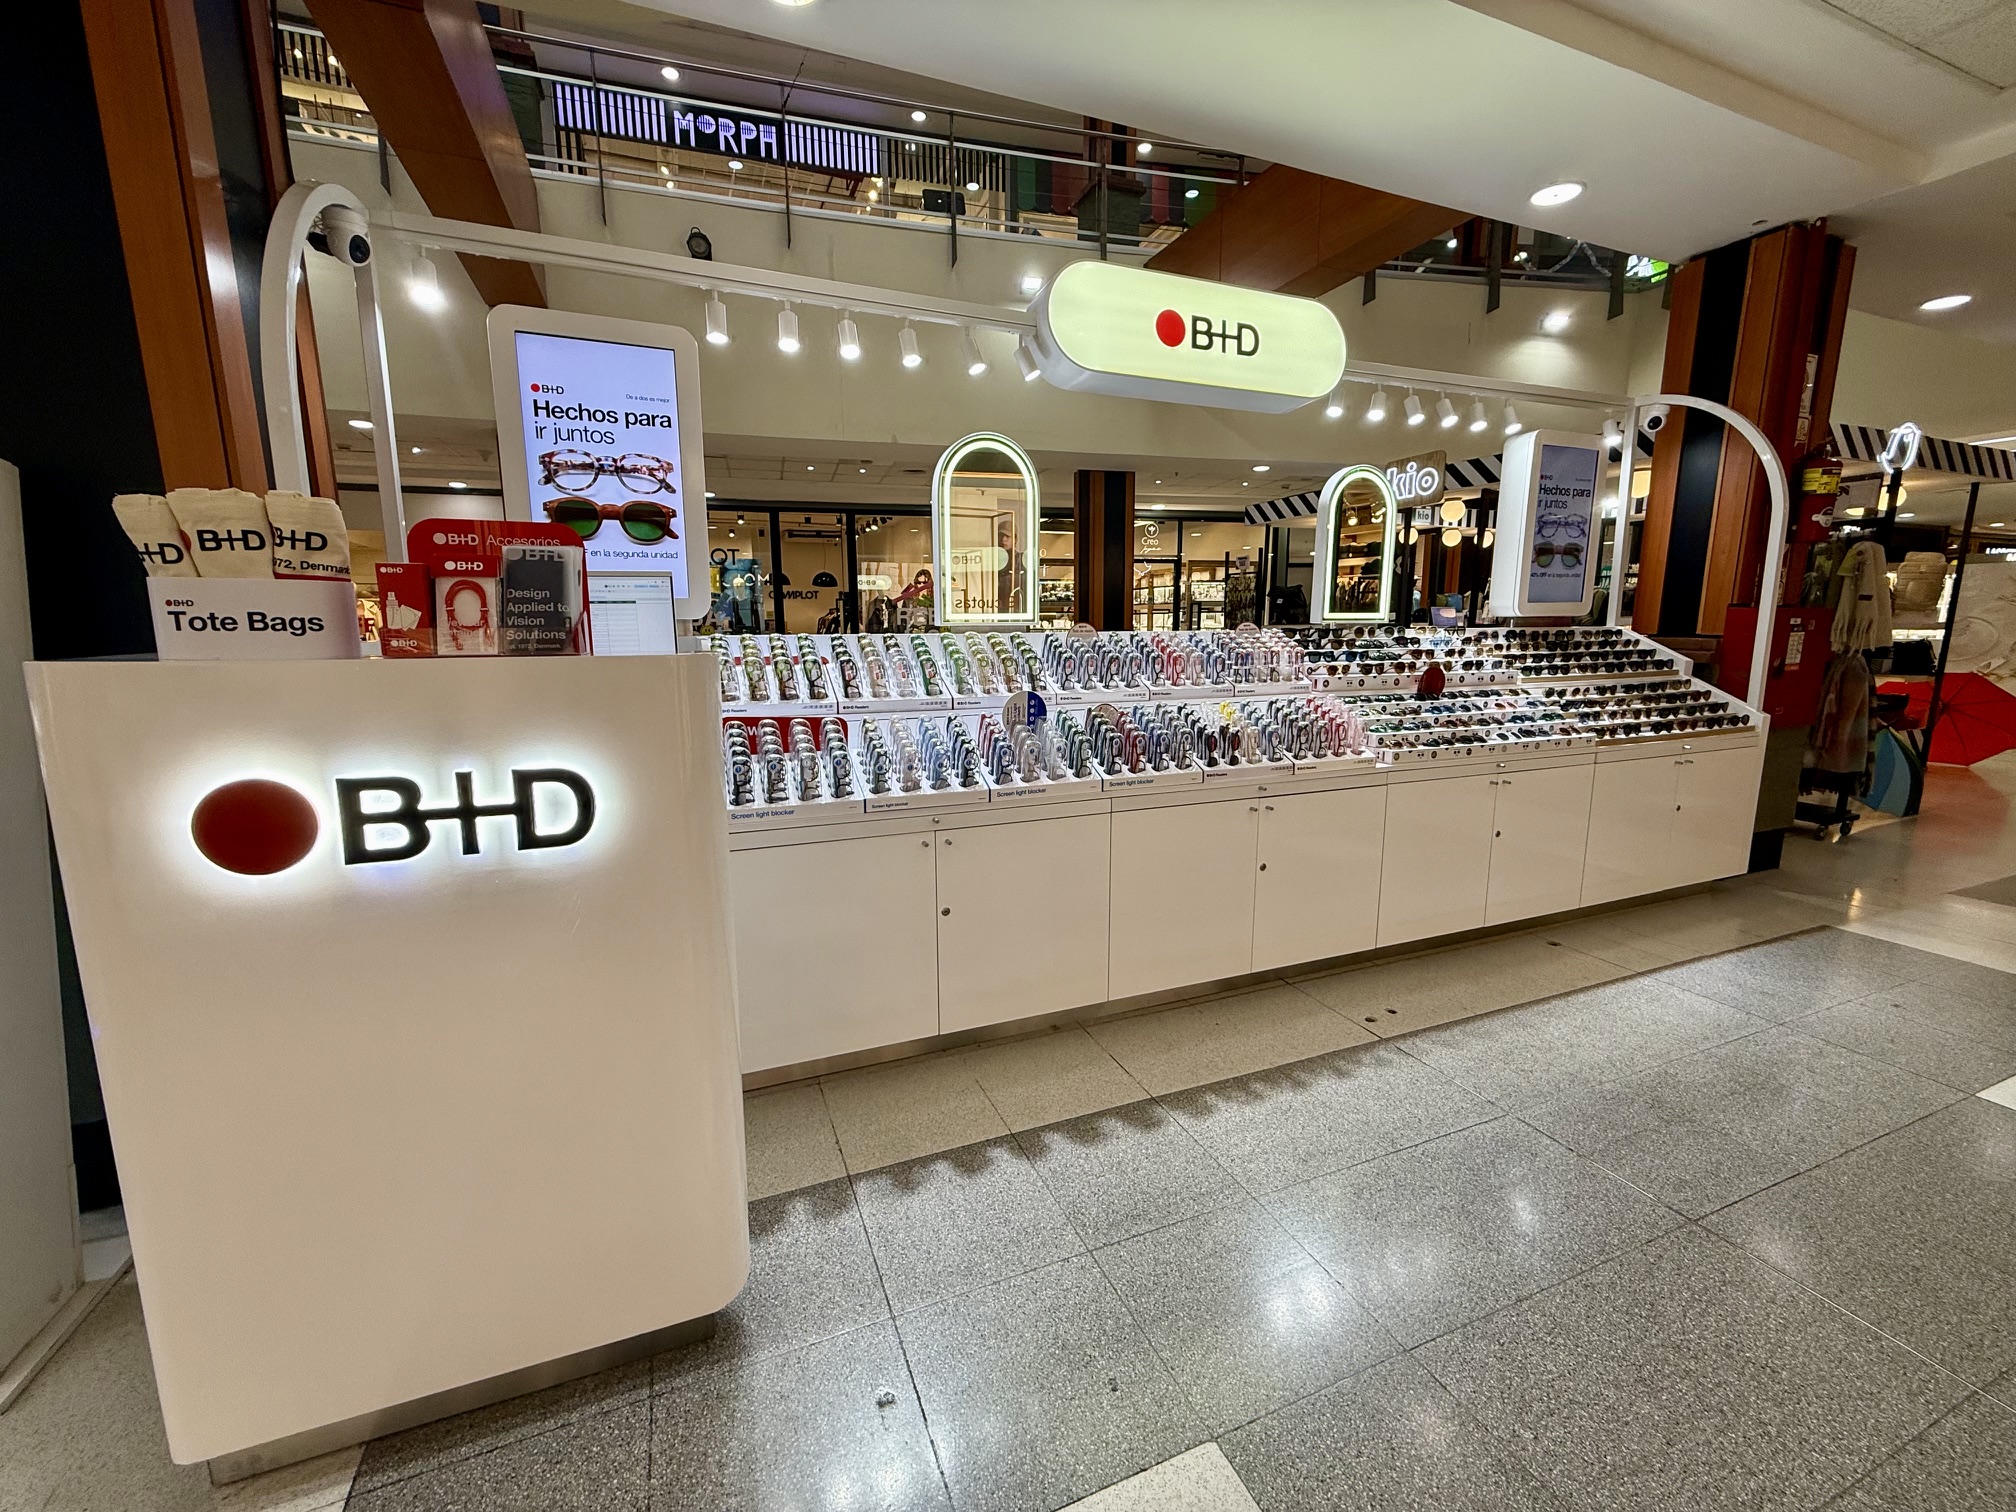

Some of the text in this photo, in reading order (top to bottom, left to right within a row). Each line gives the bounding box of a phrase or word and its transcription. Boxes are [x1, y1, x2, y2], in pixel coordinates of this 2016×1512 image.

[673, 110, 778, 159] MORPH
[1191, 315, 1260, 357] B+D
[541, 384, 565, 394] B+D
[533, 399, 672, 429] Hechos para
[535, 421, 615, 445] ir juntos
[1386, 461, 1439, 500] kio
[1540, 483, 1591, 499] Hechos para
[1544, 497, 1568, 510] juntos
[1417, 511, 1429, 520] kio
[197, 529, 267, 551] B+D
[448, 533, 561, 547] B+D Accesorios
[1141, 537, 1159, 546] Creo
[590, 549, 679, 559] en la segunda unidad
[709, 548, 740, 565] OT
[457, 561, 484, 571] B+D
[507, 588, 550, 600] Design
[769, 591, 819, 599] CMPLOT
[173, 599, 194, 607] B+D
[507, 602, 570, 613] Applied to
[167, 610, 324, 636] Tote Bags
[507, 616, 545, 626] Vision
[506, 629, 567, 640] Solutions
[335, 767, 596, 866] B+D
